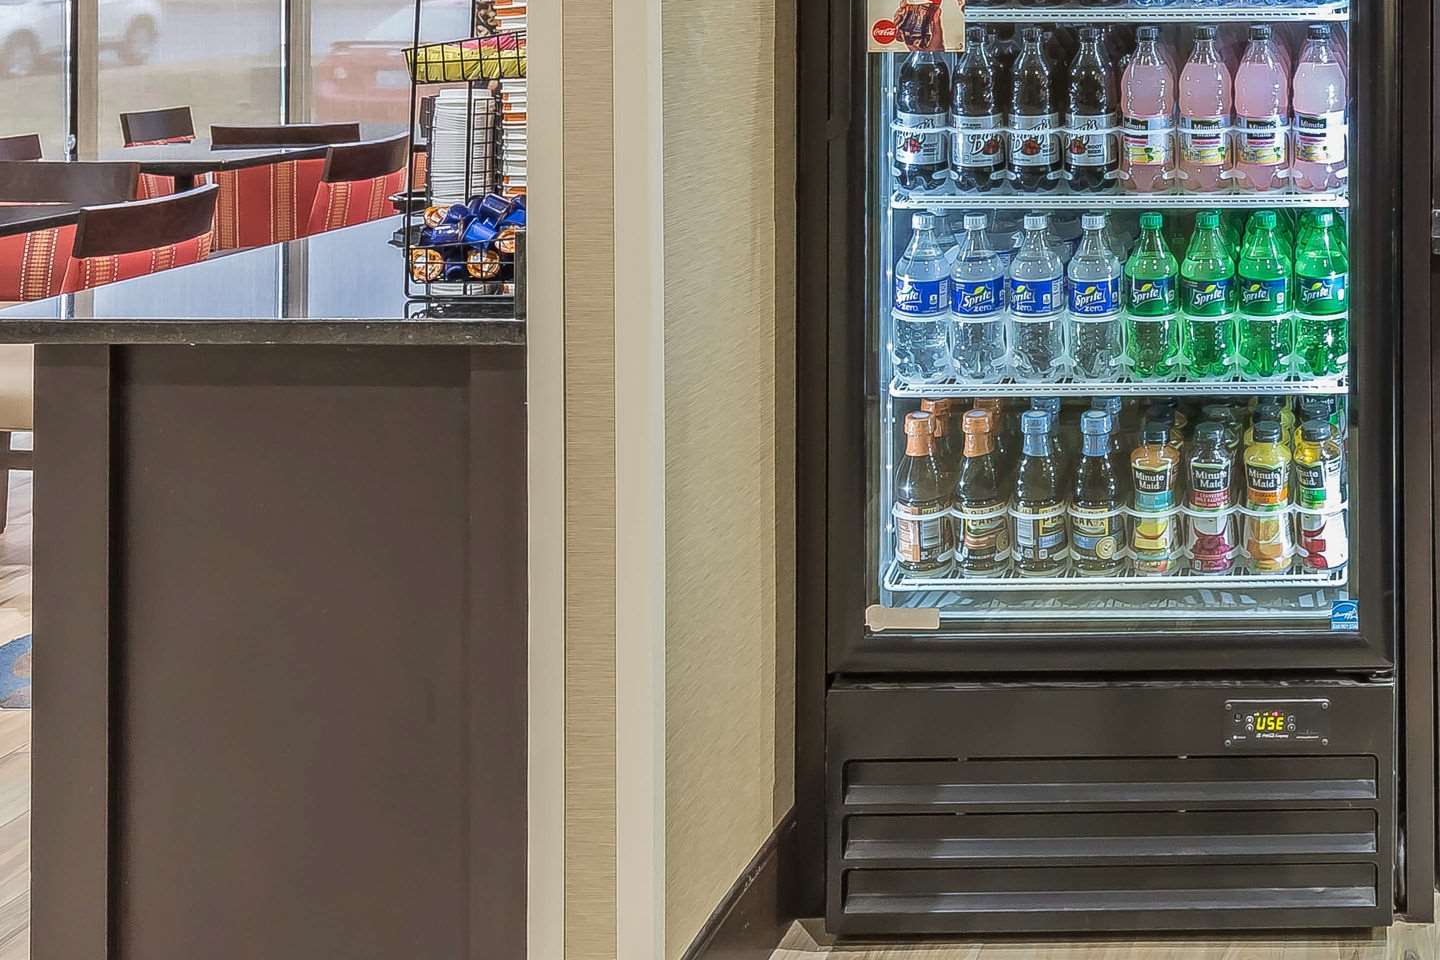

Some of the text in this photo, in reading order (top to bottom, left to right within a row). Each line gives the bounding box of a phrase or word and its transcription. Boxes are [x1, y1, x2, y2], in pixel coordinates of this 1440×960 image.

[962, 289, 993, 308] Sprite
[1075, 290, 1102, 308] Sprite
[1132, 289, 1160, 307] Sprite
[1194, 289, 1223, 307] Sprite
[1242, 289, 1267, 306] Sprite
[1302, 288, 1330, 307] Sprite
[1135, 470, 1165, 481] Minute
[1248, 468, 1279, 480] Minute
[1139, 481, 1161, 490] Maid
[1253, 479, 1276, 489] Maid
[1256, 716, 1284, 730] USE
